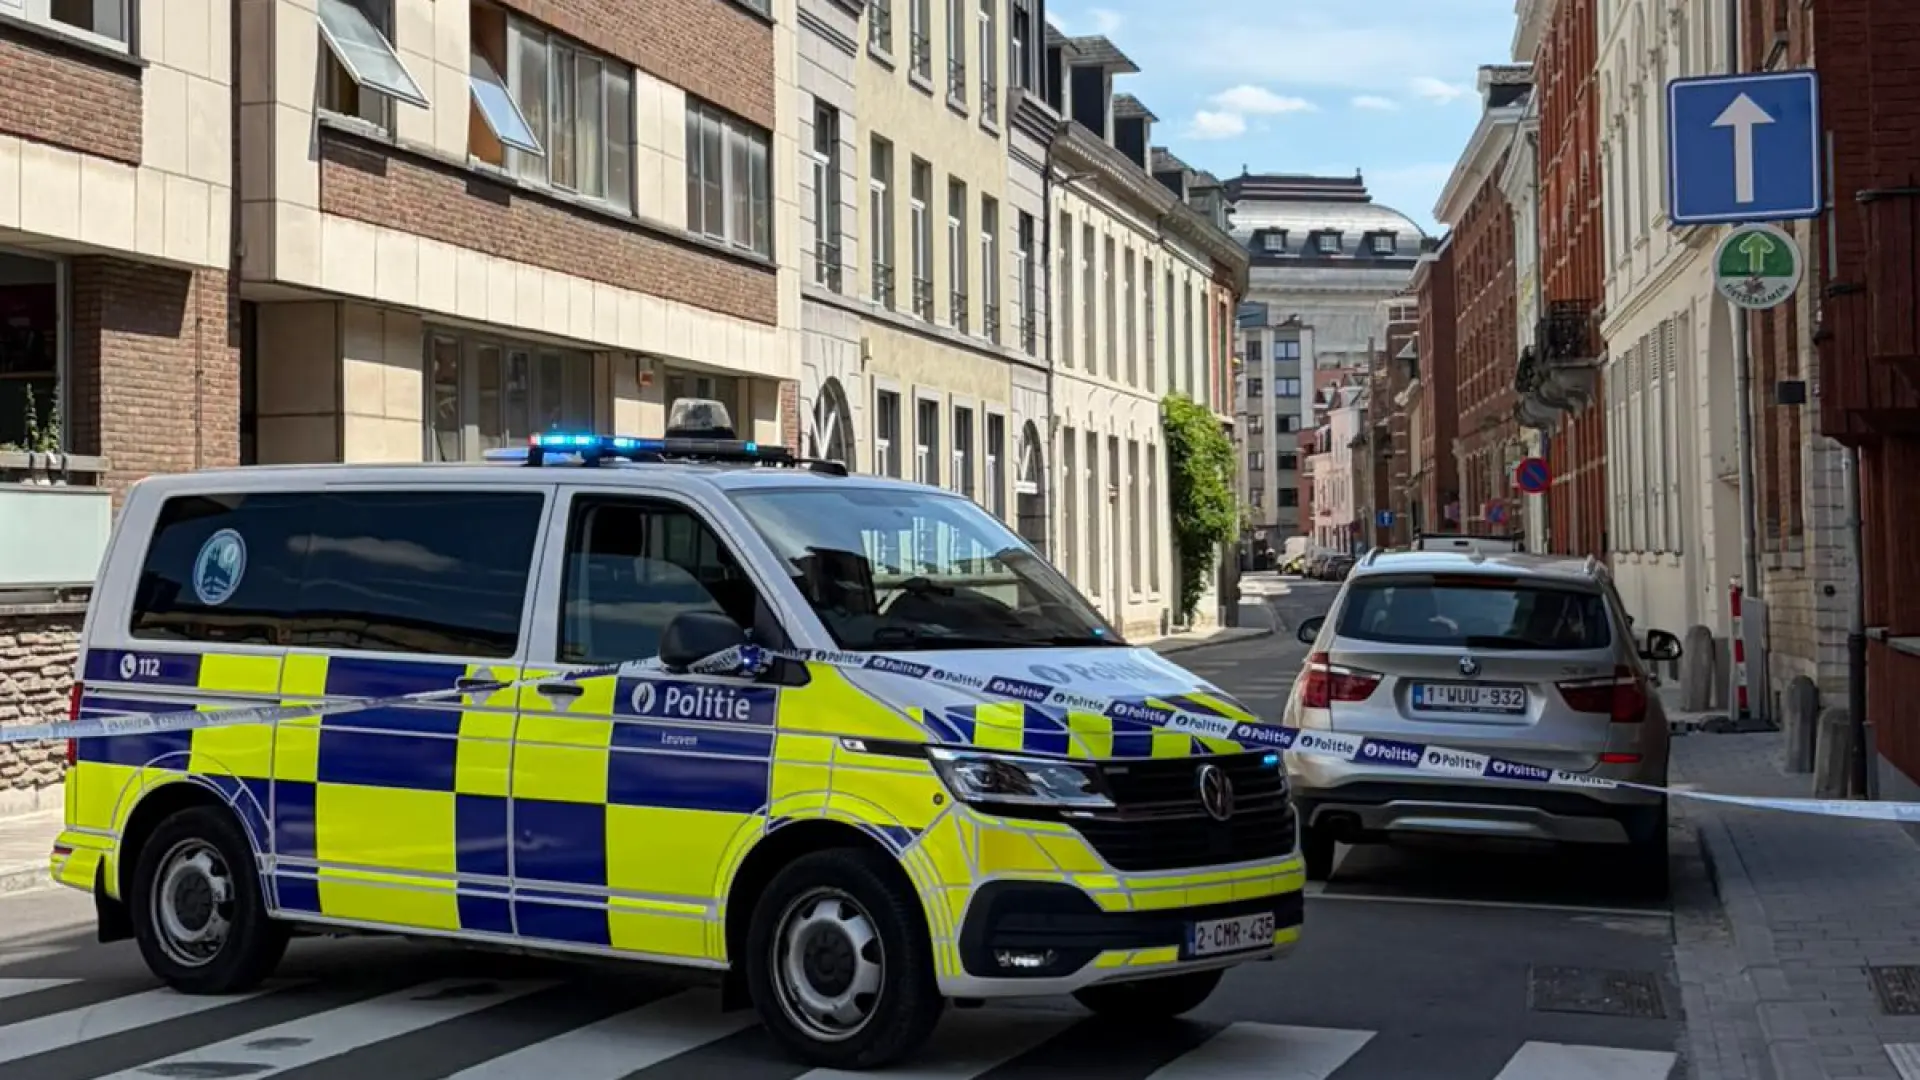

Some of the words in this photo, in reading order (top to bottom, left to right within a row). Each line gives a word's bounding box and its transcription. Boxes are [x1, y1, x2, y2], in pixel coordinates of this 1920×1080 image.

[139, 658, 160, 675] 112
[664, 687, 750, 720] Politie
[885, 661, 924, 675] Politie
[945, 671, 983, 688] Politie
[1005, 682, 1045, 699] Politie
[1068, 695, 1105, 711] Politie
[1127, 706, 1166, 723] Politie
[1189, 718, 1228, 734] Politie
[1251, 727, 1291, 744] Politie
[1314, 736, 1354, 754] Politie
[1378, 744, 1419, 763] Politie
[1442, 753, 1483, 771] Politie
[1507, 763, 1548, 778] Politie
[661, 731, 698, 746] Leuven
[1197, 916, 1273, 950] 2-CMR-435
